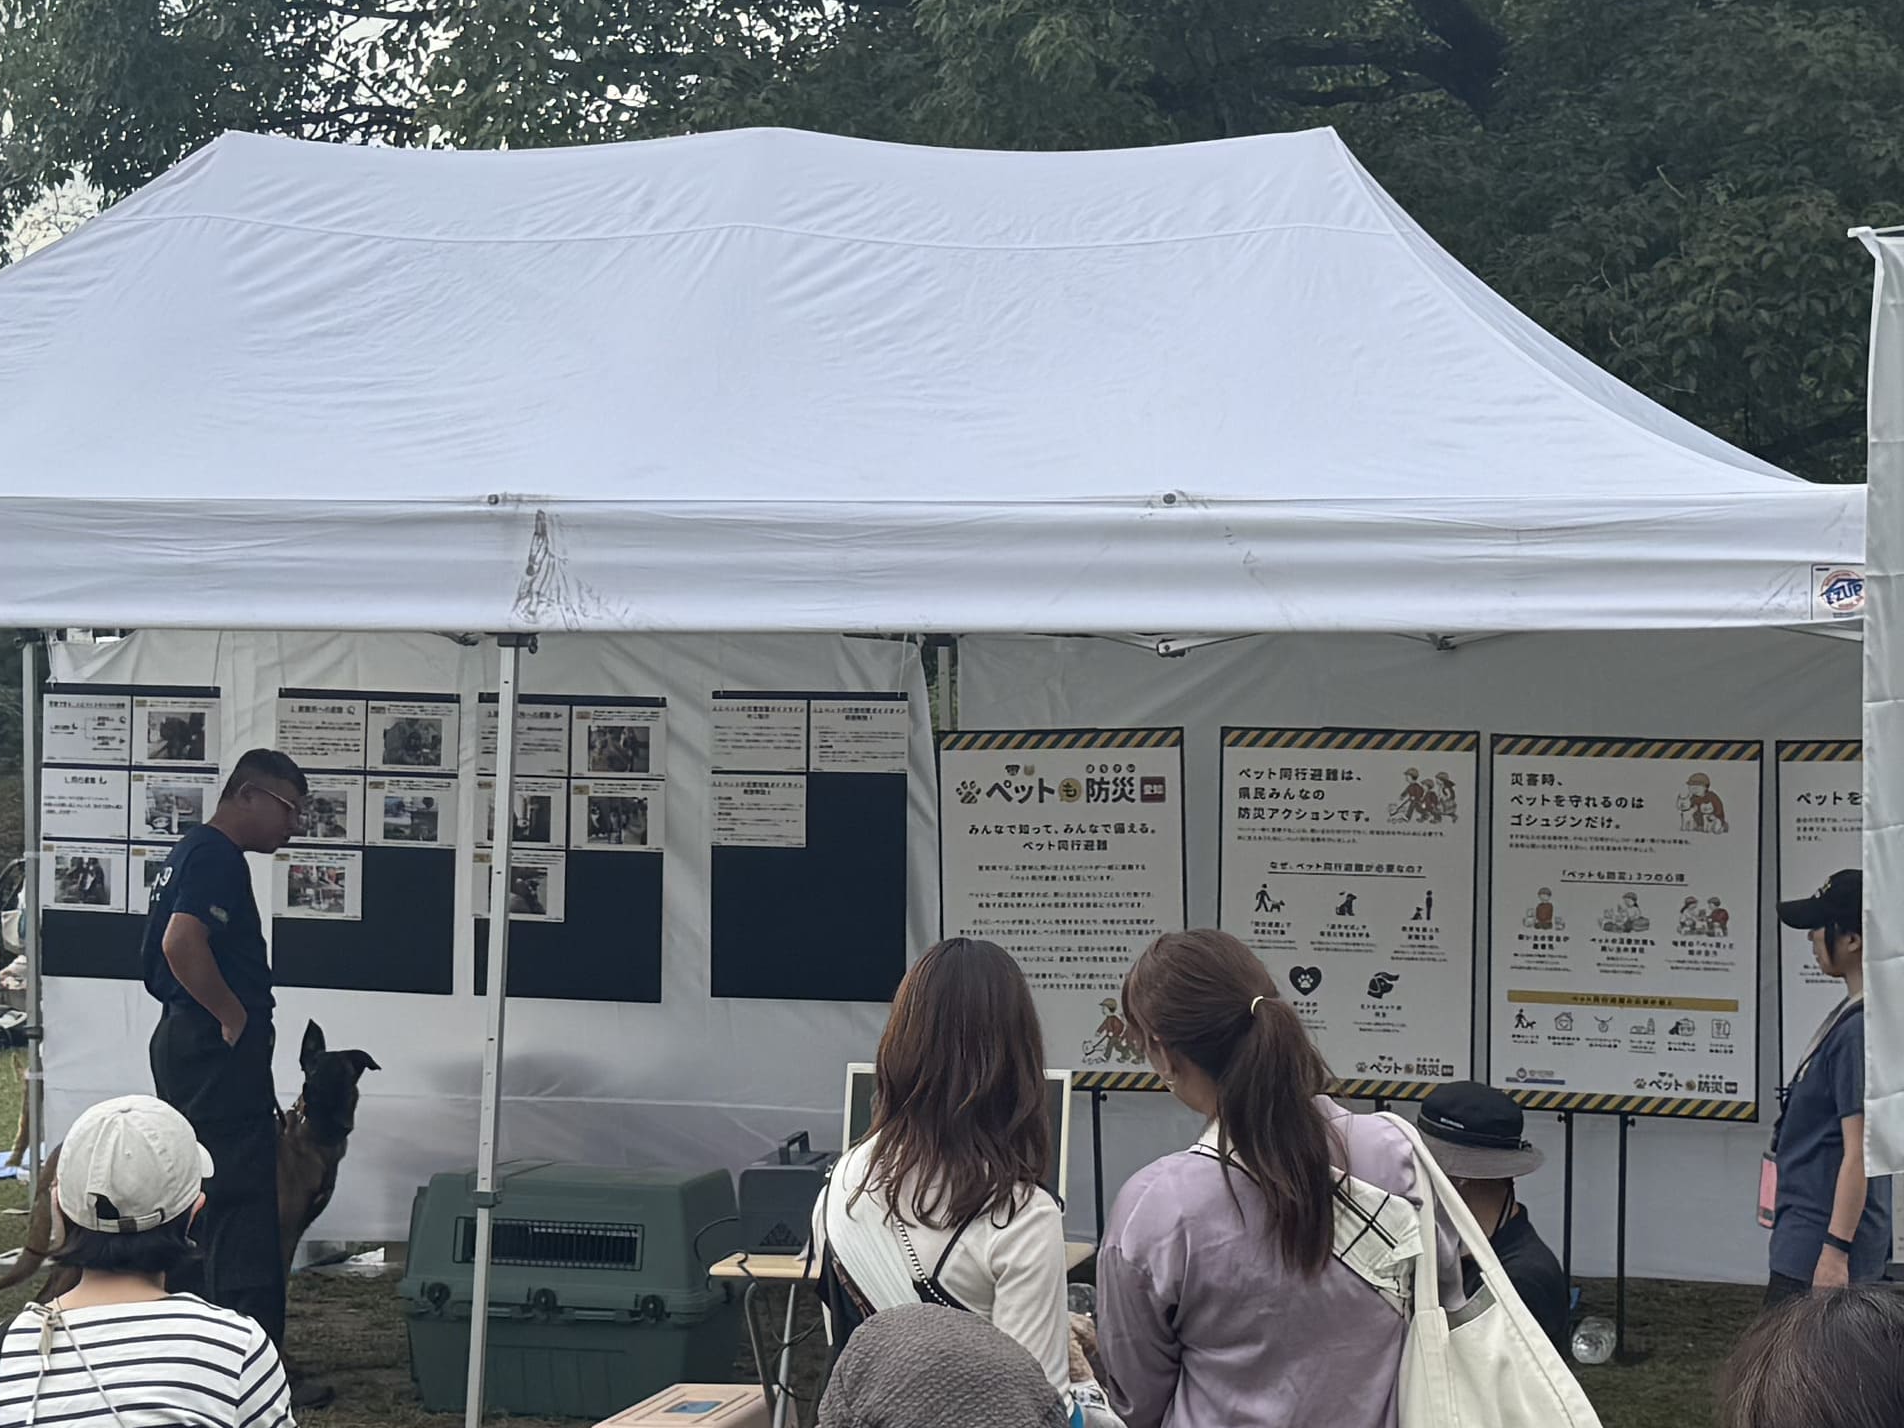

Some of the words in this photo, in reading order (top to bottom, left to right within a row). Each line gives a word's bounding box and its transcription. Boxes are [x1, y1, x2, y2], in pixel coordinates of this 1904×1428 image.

[1511, 772, 1564, 787] 災害時、
[986, 776, 1136, 803] ペットも防災
[1238, 787, 1325, 801] 県民みんなの
[1511, 794, 1644, 809] ペットを守れるのは
[1237, 807, 1370, 822] 防災アクションです。
[1510, 813, 1620, 830] ゴシュジンだけ。
